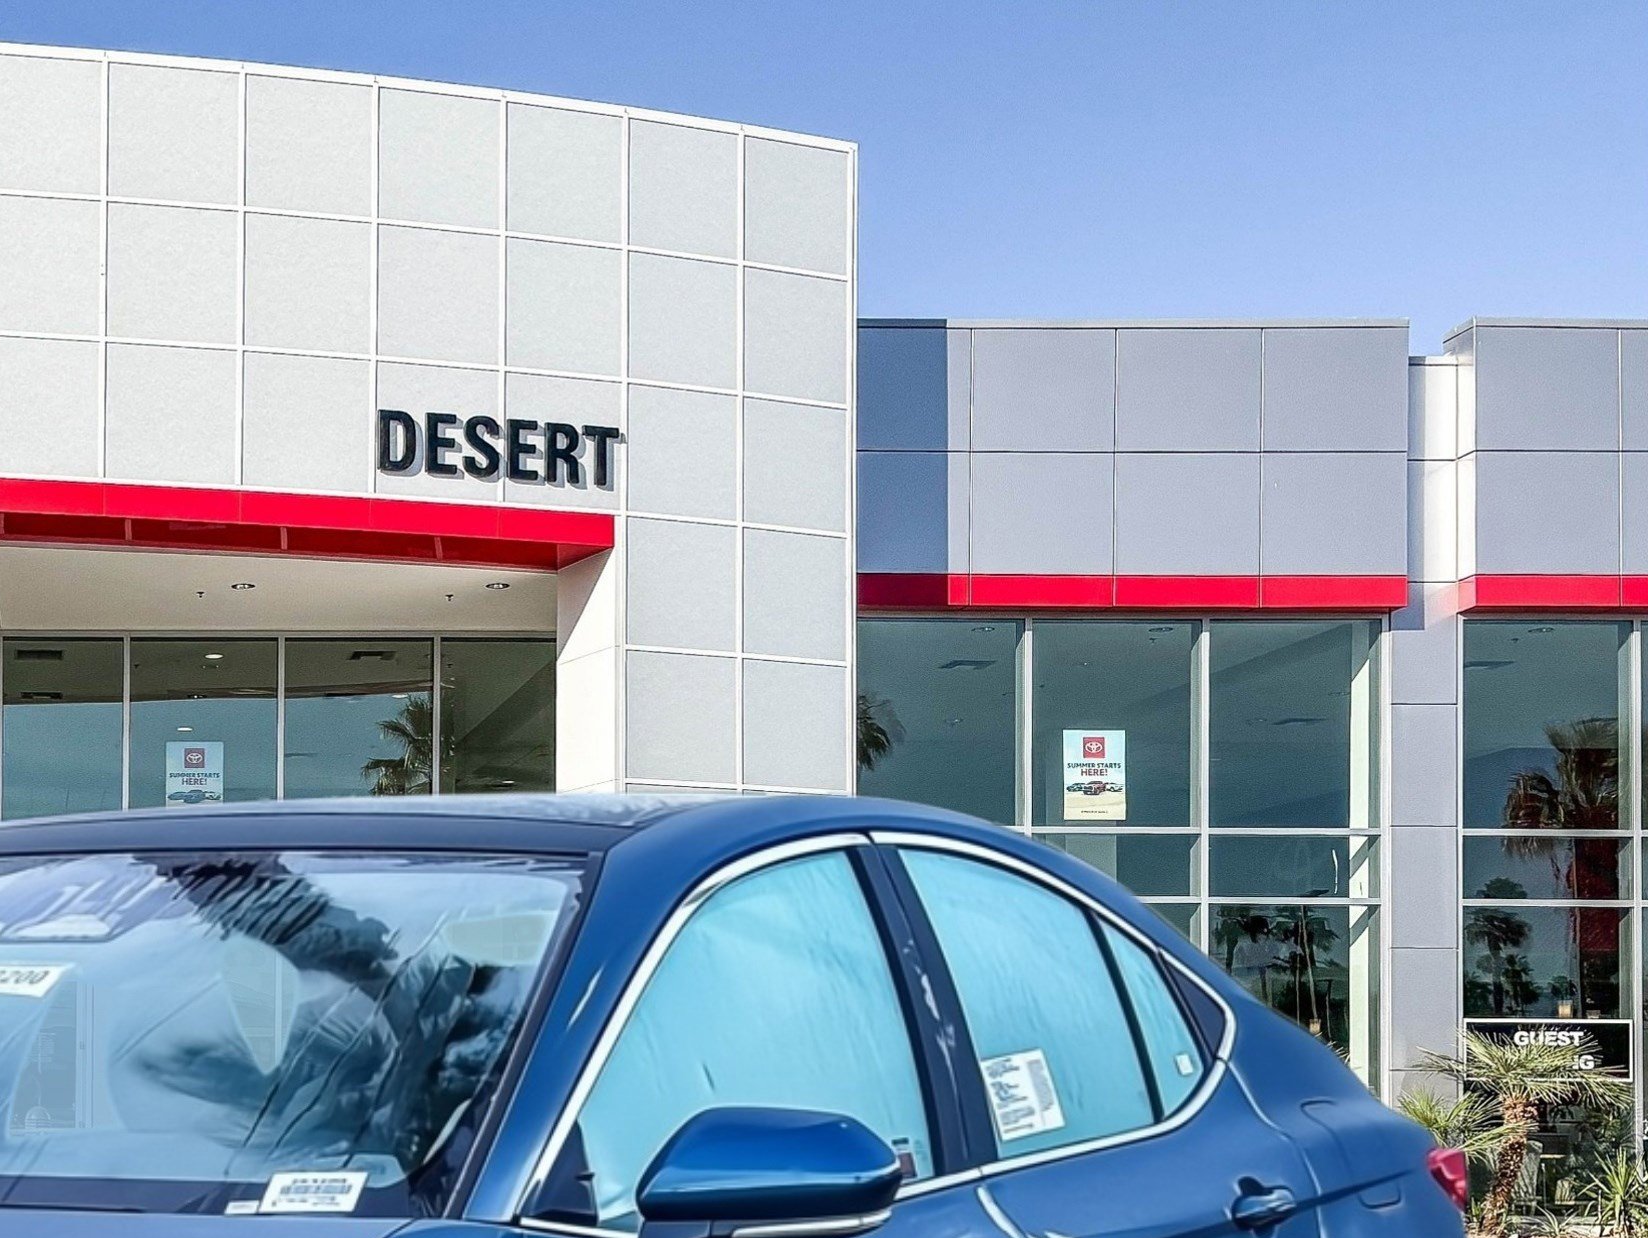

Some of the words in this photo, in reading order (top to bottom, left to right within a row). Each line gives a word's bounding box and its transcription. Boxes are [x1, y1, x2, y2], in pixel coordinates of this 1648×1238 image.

[377, 409, 620, 486] DESERT
[1080, 769, 1108, 777] HERE!
[181, 778, 208, 786] HERE!
[1513, 1030, 1585, 1047] GUEST
